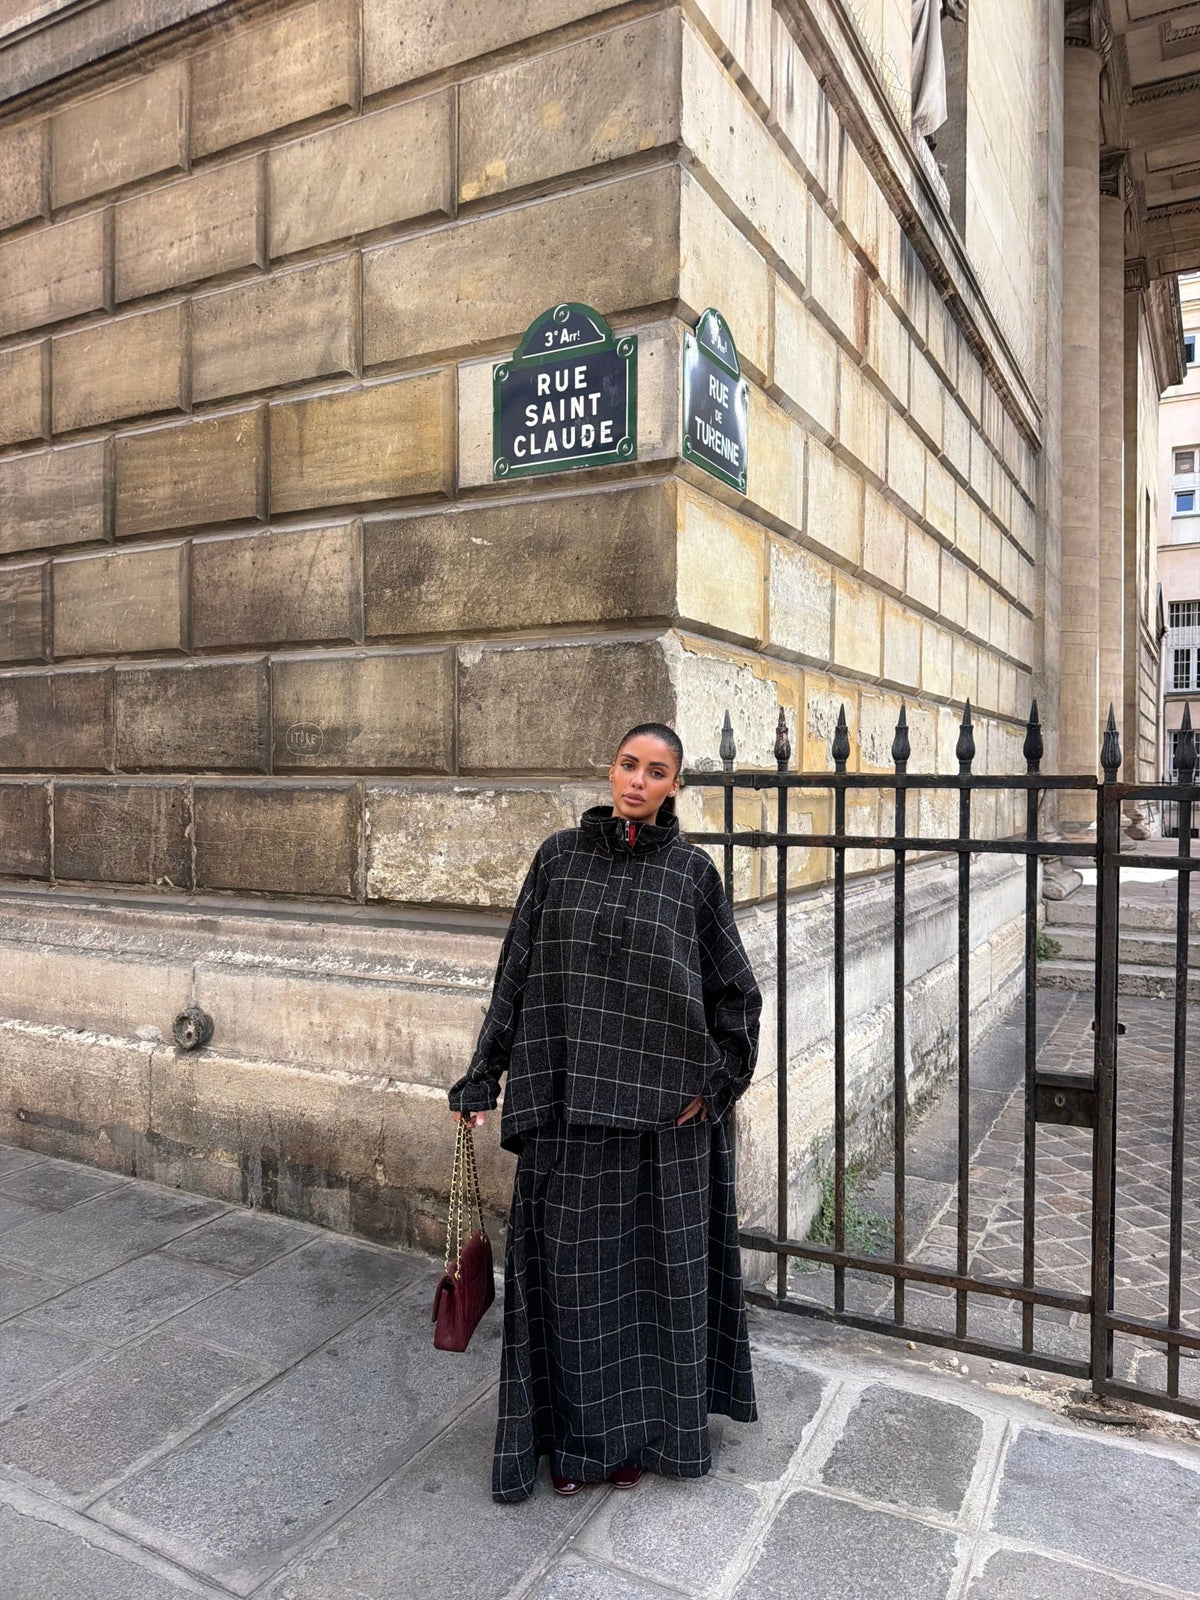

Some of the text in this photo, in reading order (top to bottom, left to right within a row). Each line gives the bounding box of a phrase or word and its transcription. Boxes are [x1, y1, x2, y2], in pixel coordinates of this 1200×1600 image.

[537, 365, 588, 396] RUE
[708, 374, 729, 409] RUE
[525, 392, 602, 427] SAINT
[714, 409, 723, 425] DE
[513, 420, 613, 458] CLAUDE
[694, 416, 740, 467] TURENNE
